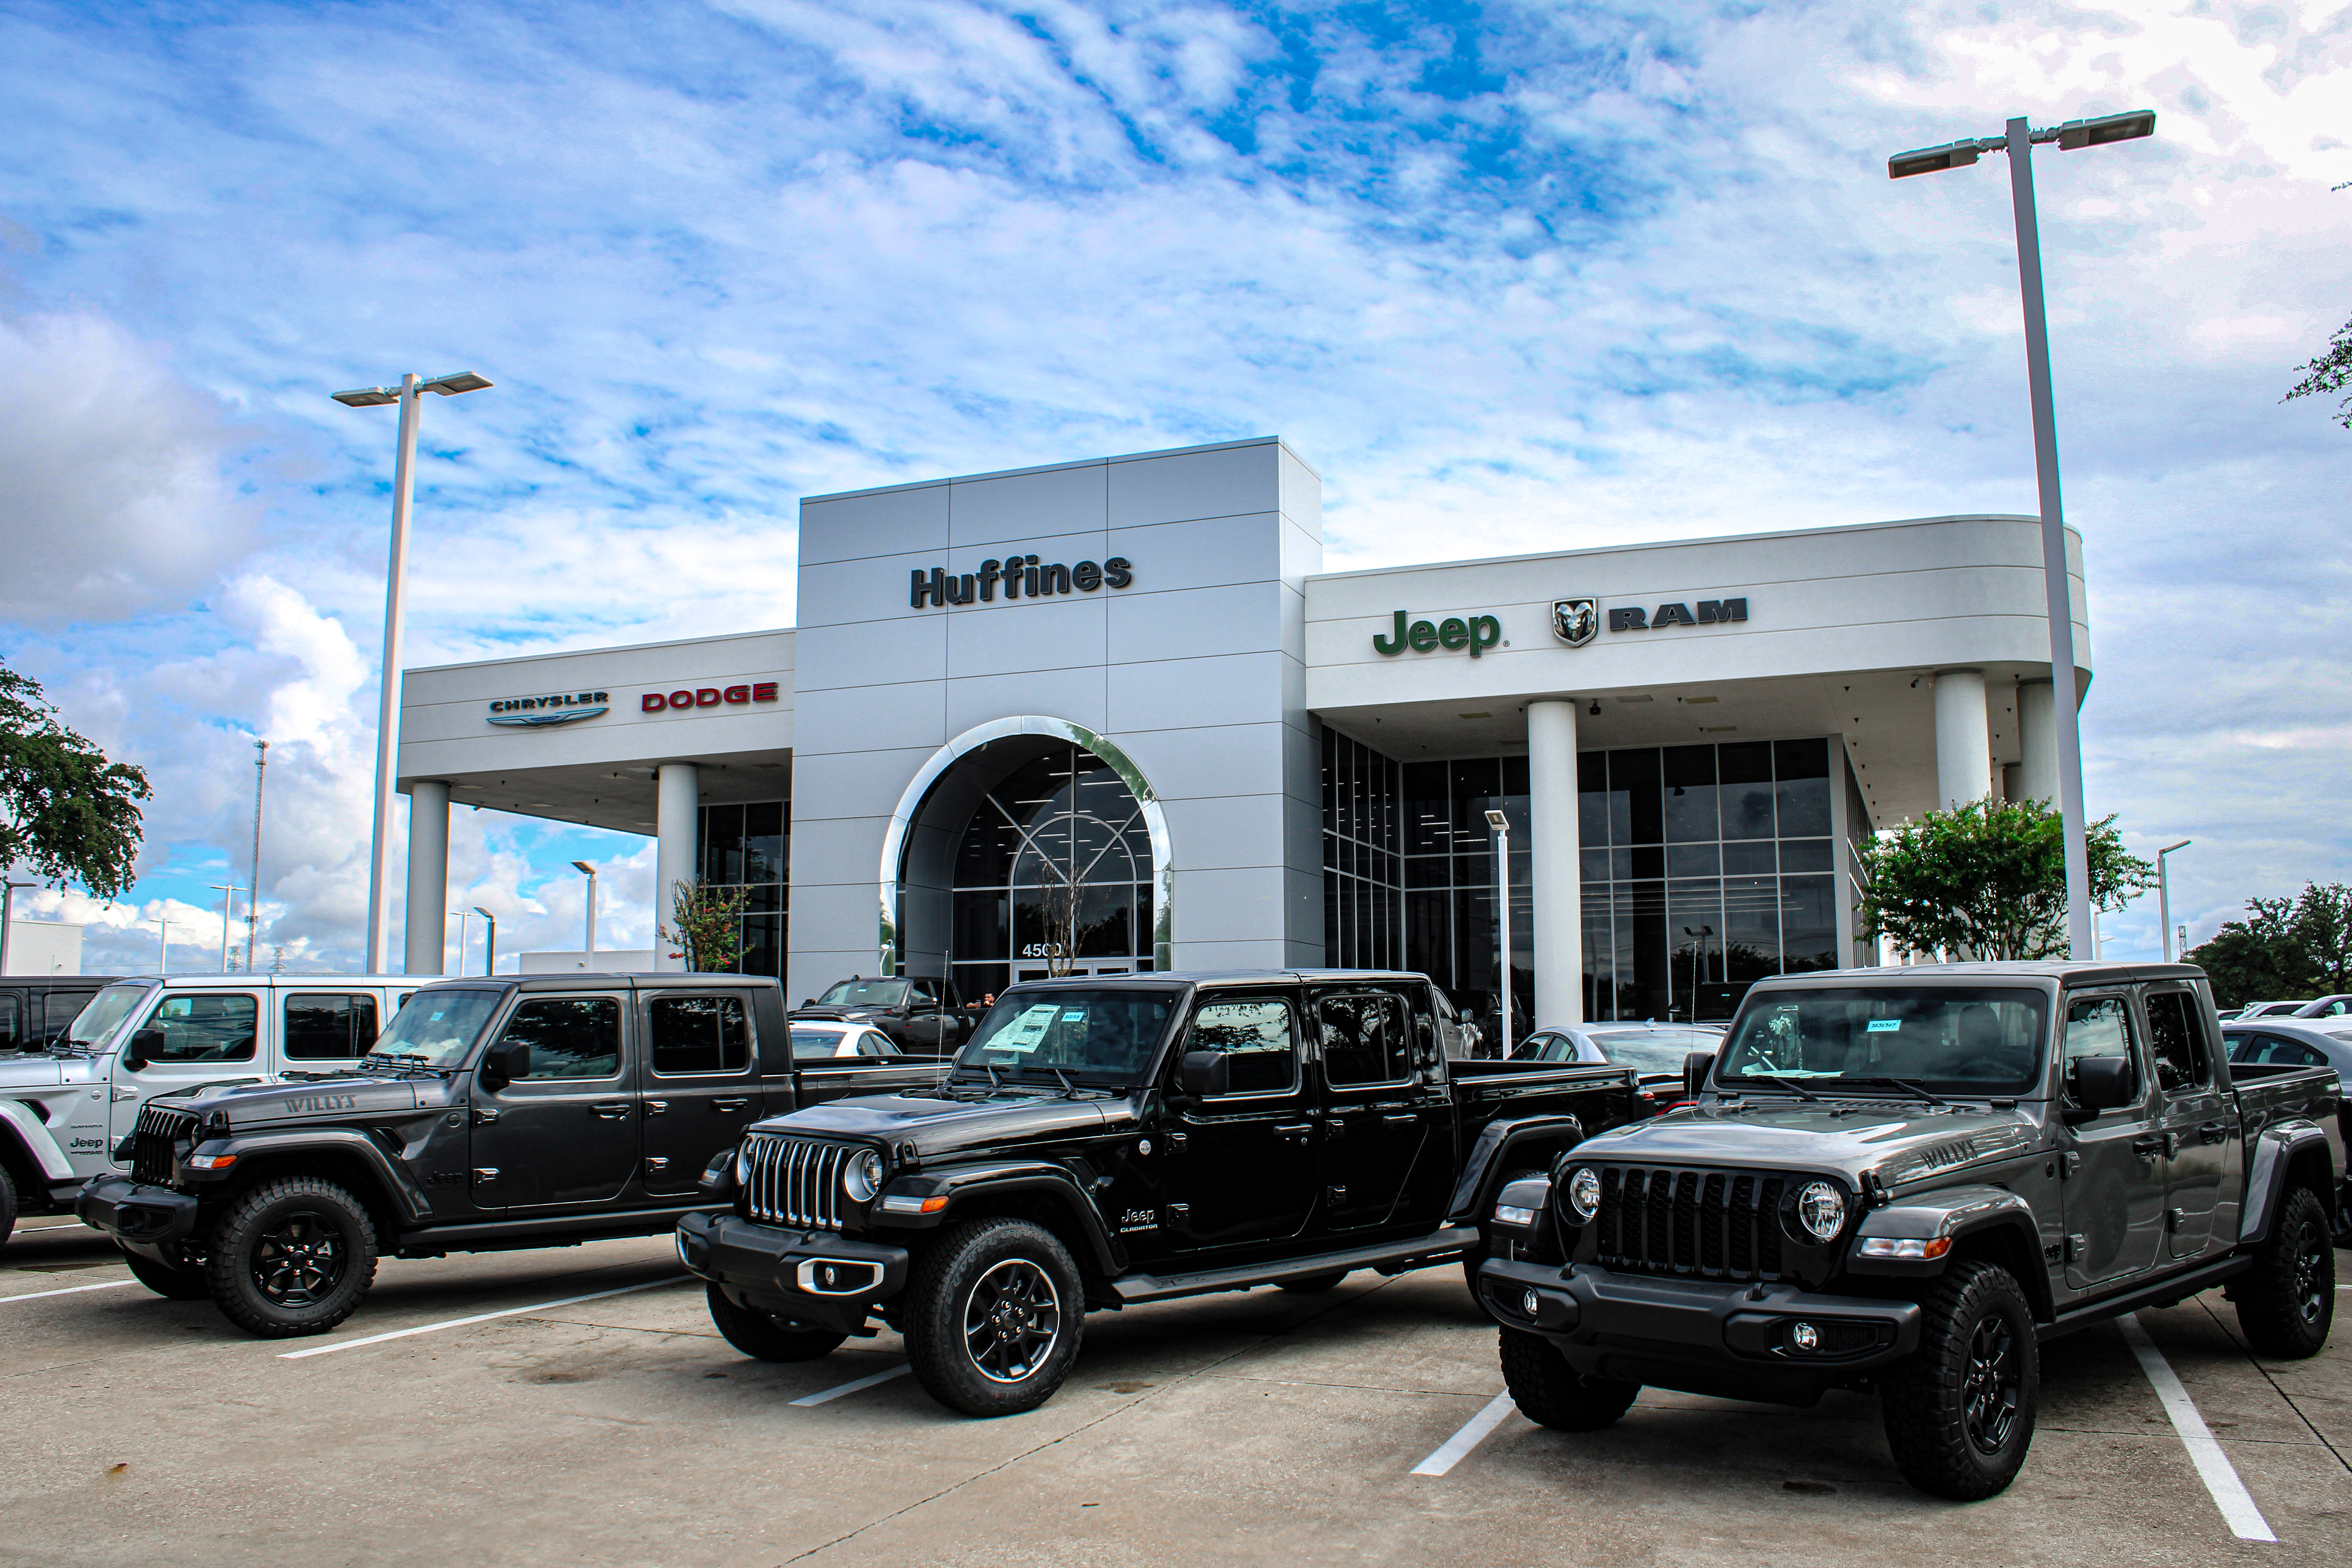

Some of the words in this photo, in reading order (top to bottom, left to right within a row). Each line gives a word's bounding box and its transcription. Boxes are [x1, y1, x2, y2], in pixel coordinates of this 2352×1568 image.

[910, 554, 1131, 608] Huffines
[1608, 597, 1748, 631] RAM
[1373, 610, 1501, 657] Jeep
[489, 691, 608, 712] CHRYSLER
[642, 681, 779, 713] DODGE
[1022, 942, 1062, 957] 4500
[284, 1094, 356, 1112] WILLYS
[70, 1136, 104, 1149] Jeep
[1917, 1139, 1978, 1169] WILLYS
[427, 1171, 463, 1184] Jeep
[1122, 1209, 1155, 1224] Jeep
[1120, 1223, 1158, 1233] GLADIATOR
[2043, 1243, 2062, 1260] eep
